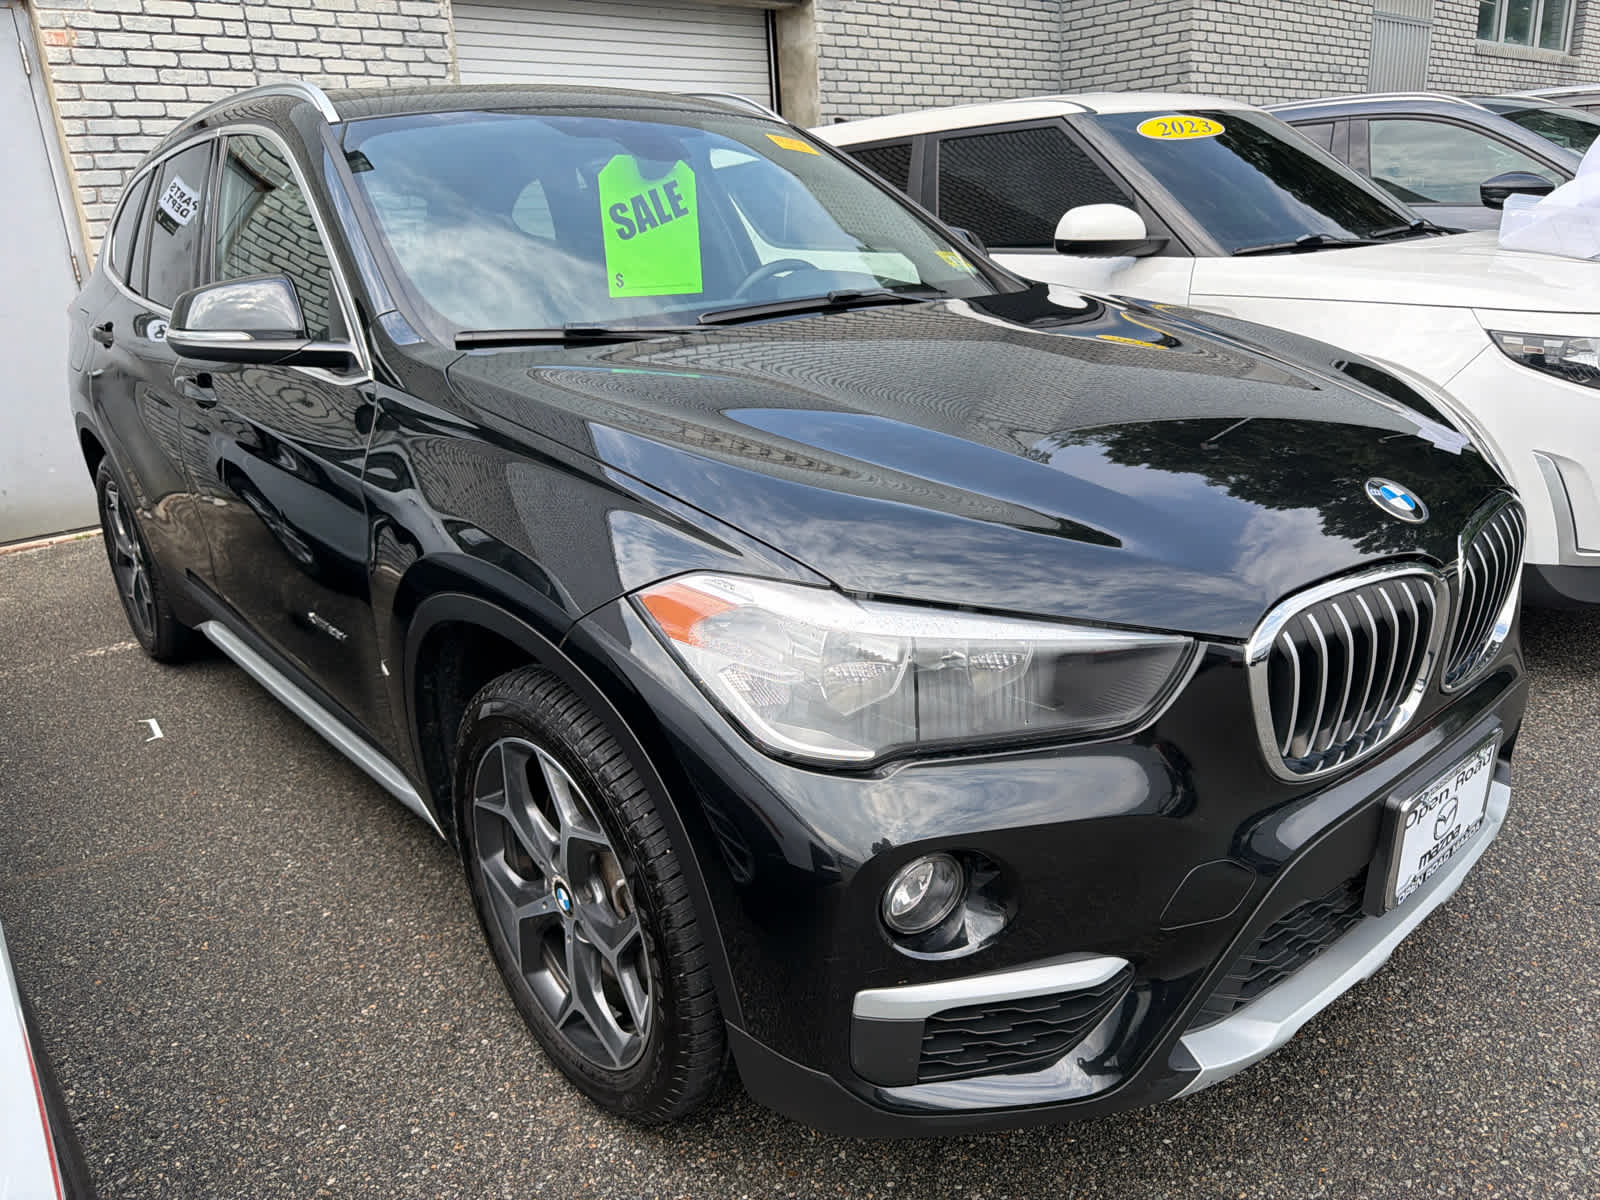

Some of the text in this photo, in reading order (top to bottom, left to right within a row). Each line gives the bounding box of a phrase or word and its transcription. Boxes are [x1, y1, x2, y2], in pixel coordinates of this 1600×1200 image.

[1157, 120, 1212, 136] 2023
[609, 180, 689, 240] SALE
[1405, 788, 1449, 829] Open
